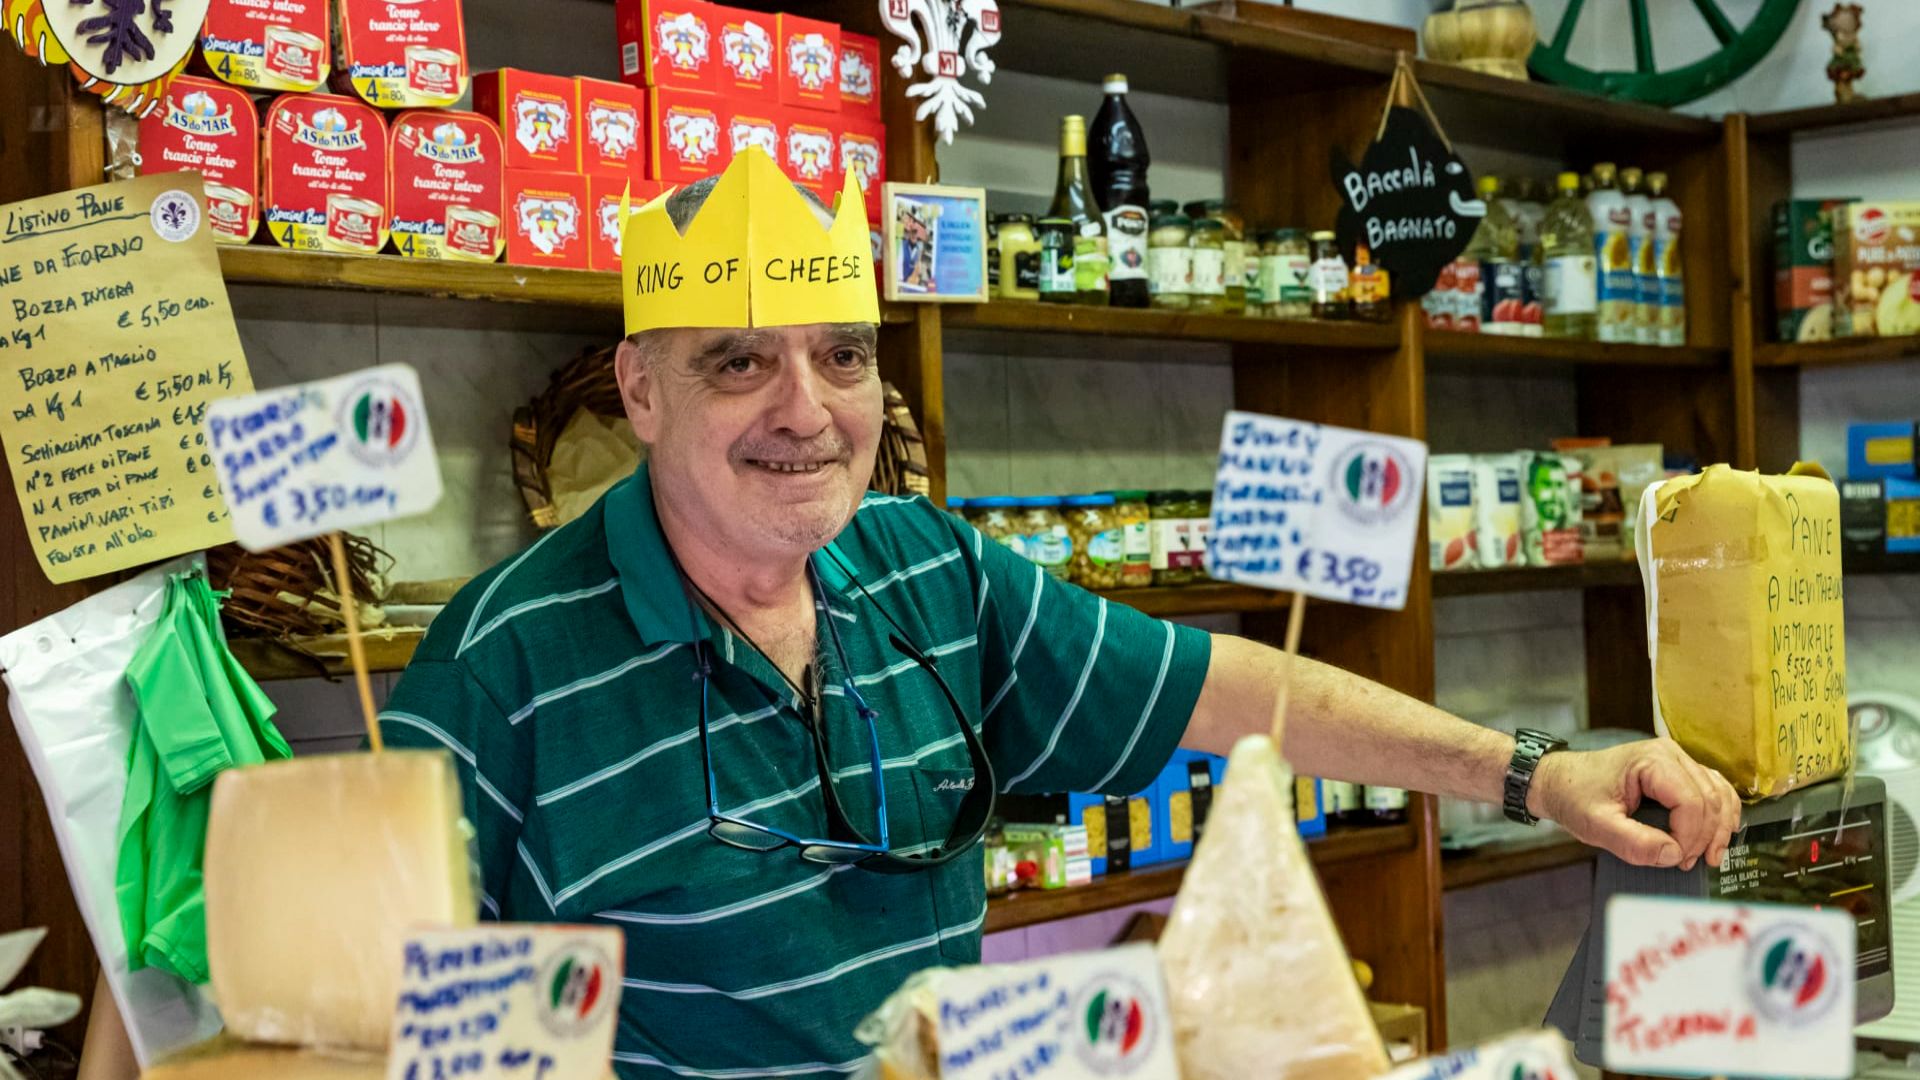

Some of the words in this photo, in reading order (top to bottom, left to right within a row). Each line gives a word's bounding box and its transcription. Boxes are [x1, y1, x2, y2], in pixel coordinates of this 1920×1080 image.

[386, 4, 420, 18] Tonno
[368, 18, 408, 31] trancio
[409, 19, 441, 32] intero
[205, 34, 242, 52] Special
[217, 54, 231, 79] 4
[351, 60, 385, 78] Special
[366, 79, 379, 102] 4
[182, 134, 218, 152] Tonno
[163, 147, 204, 164] trancio
[204, 153, 237, 168] intero
[311, 149, 348, 166] Tonno
[292, 162, 333, 179] trancio
[334, 167, 367, 181] intero
[432, 162, 466, 179] Tonno
[413, 175, 453, 190] trancio
[453, 180, 484, 193] intero
[76, 192, 125, 220] PANE
[269, 204, 305, 222] Special
[281, 224, 295, 248] 4
[1366, 214, 1457, 250] BAGNATO
[34, 258, 58, 276] DA
[62, 235, 144, 268] FORNO
[402, 234, 415, 257] 4
[635, 261, 684, 297] KING
[703, 257, 740, 285] OF
[764, 254, 862, 285] CHEESE
[12, 295, 77, 322] BOZZA
[81, 281, 135, 307] INTERA
[117, 311, 134, 329] €
[141, 299, 181, 328] 5,50
[12, 328, 33, 349] Kg
[35, 323, 46, 341] 1
[19, 362, 77, 391] BOZZA
[85, 361, 96, 377] A
[100, 344, 157, 373] TAGLIO
[135, 381, 150, 401] €
[157, 374, 194, 402] 5,50
[13, 403, 36, 422] DA
[71, 390, 83, 408] 1
[21, 430, 103, 465] SCHIACCIATA
[103, 416, 161, 442] TOSCANA
[61, 462, 96, 484] FETTE
[117, 445, 152, 465] PANE
[33, 497, 45, 516] N
[51, 496, 62, 512] 1
[125, 467, 160, 486] PANE
[38, 510, 95, 544] PANINI
[97, 496, 136, 527] VARI
[1785, 491, 1834, 557] PANE
[46, 543, 98, 567] FRUSTA
[1320, 551, 1382, 587] 3,50
[1768, 575, 1781, 613] A
[1773, 621, 1835, 657] NATURALE
[1771, 669, 1798, 710] PANE
[1803, 677, 1818, 702] DEI
[1777, 705, 1838, 757] ANTICHI
[1730, 844, 1750, 857] OMEGA
[1811, 840, 1820, 863] 0
[1731, 857, 1746, 871] TWIN
[1720, 873, 1738, 886] OMEGA
